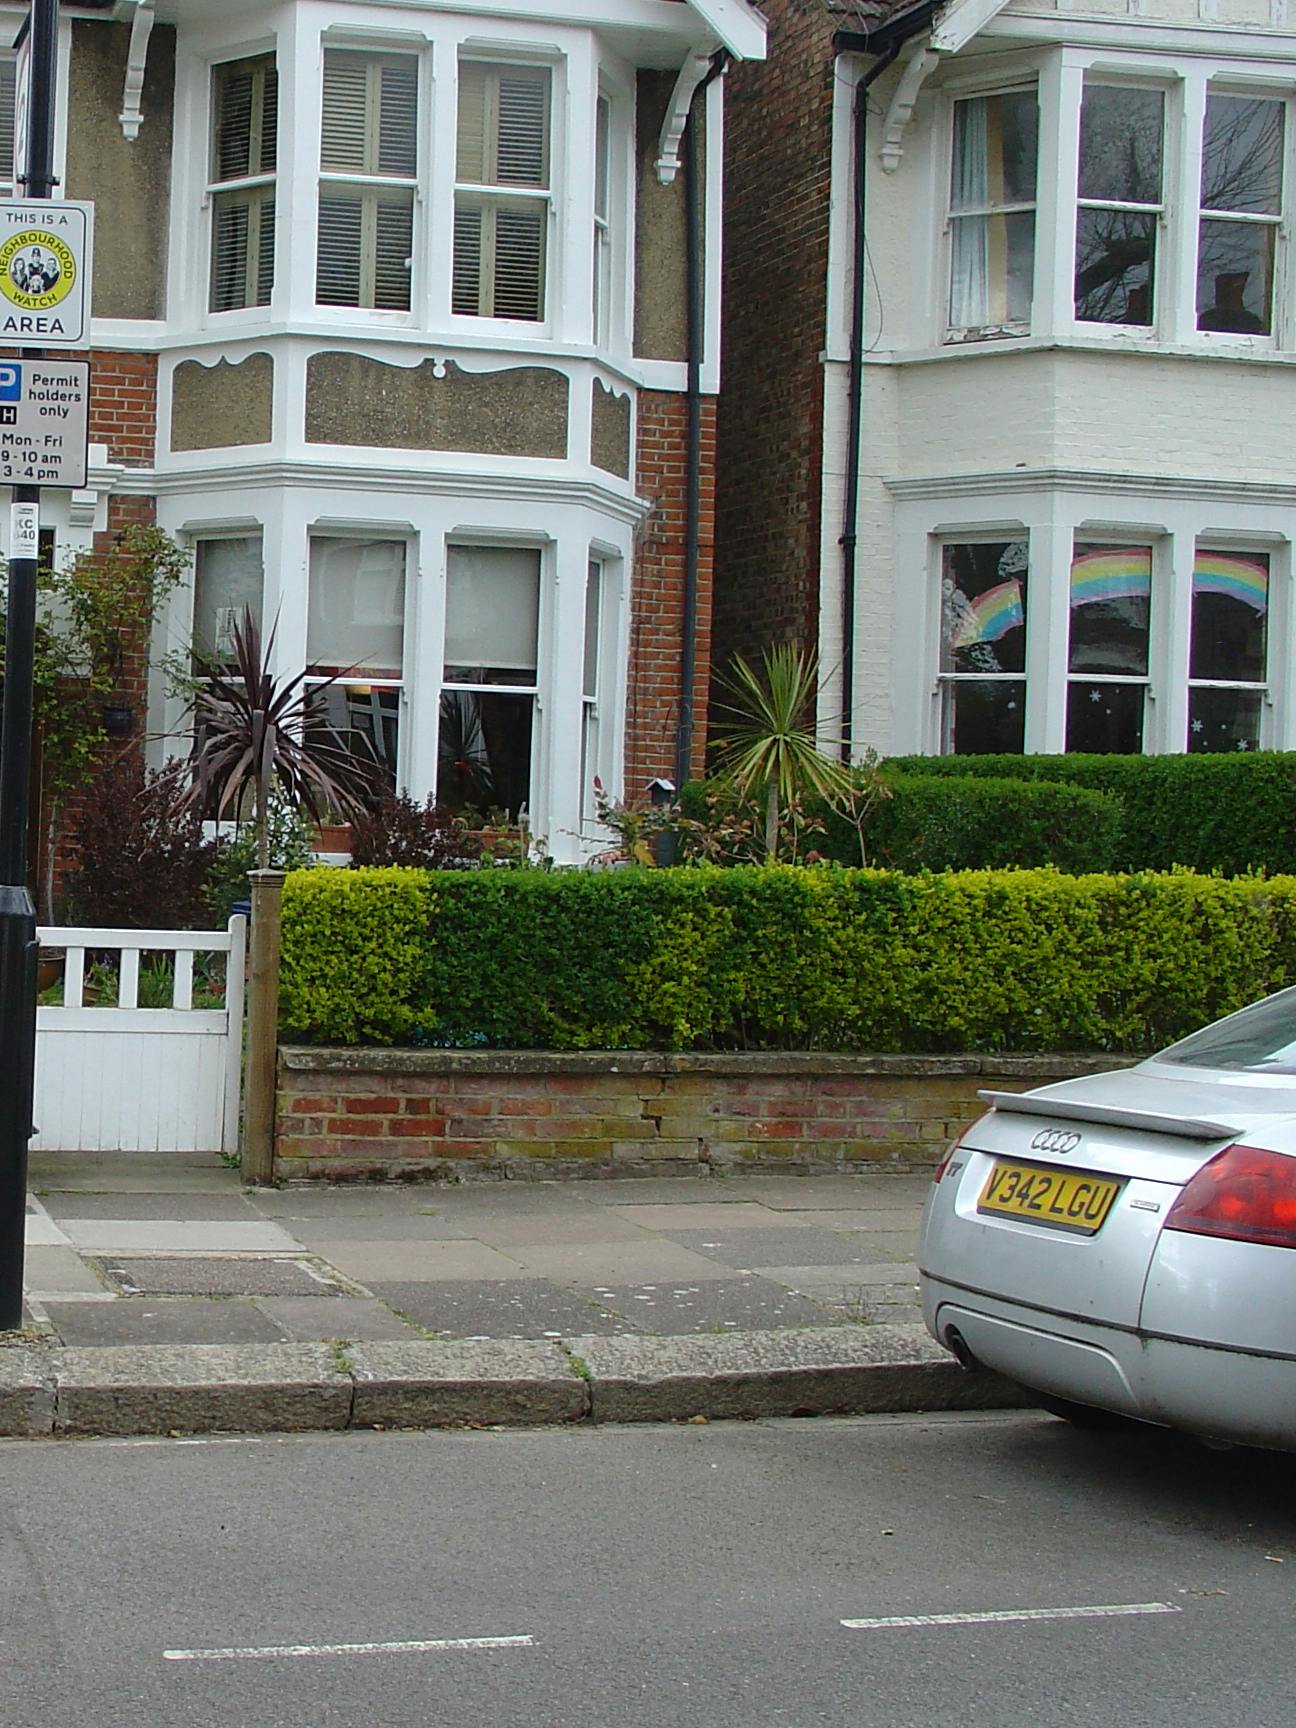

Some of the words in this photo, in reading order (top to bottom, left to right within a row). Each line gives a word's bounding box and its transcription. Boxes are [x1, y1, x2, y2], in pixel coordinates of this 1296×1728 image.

[6, 212, 36, 224] THIS
[42, 214, 54, 225] IS
[59, 215, 68, 226] A
[12, 291, 58, 307] WATCH
[3, 316, 65, 334] AREA
[32, 373, 79, 387] Permit
[28, 388, 81, 402] holders
[39, 404, 69, 419] only
[2, 433, 32, 446] Mon
[44, 435, 63, 447] Fri
[1, 450, 10, 462] 9
[22, 451, 38, 463] 10
[41, 454, 62, 464] am
[3, 465, 12, 477] 3
[24, 466, 34, 478] 4
[37, 468, 59, 480] pm
[16, 530, 36, 540] 40
[985, 1168, 1052, 1211] V342
[1048, 1179, 1111, 1220] LGU
